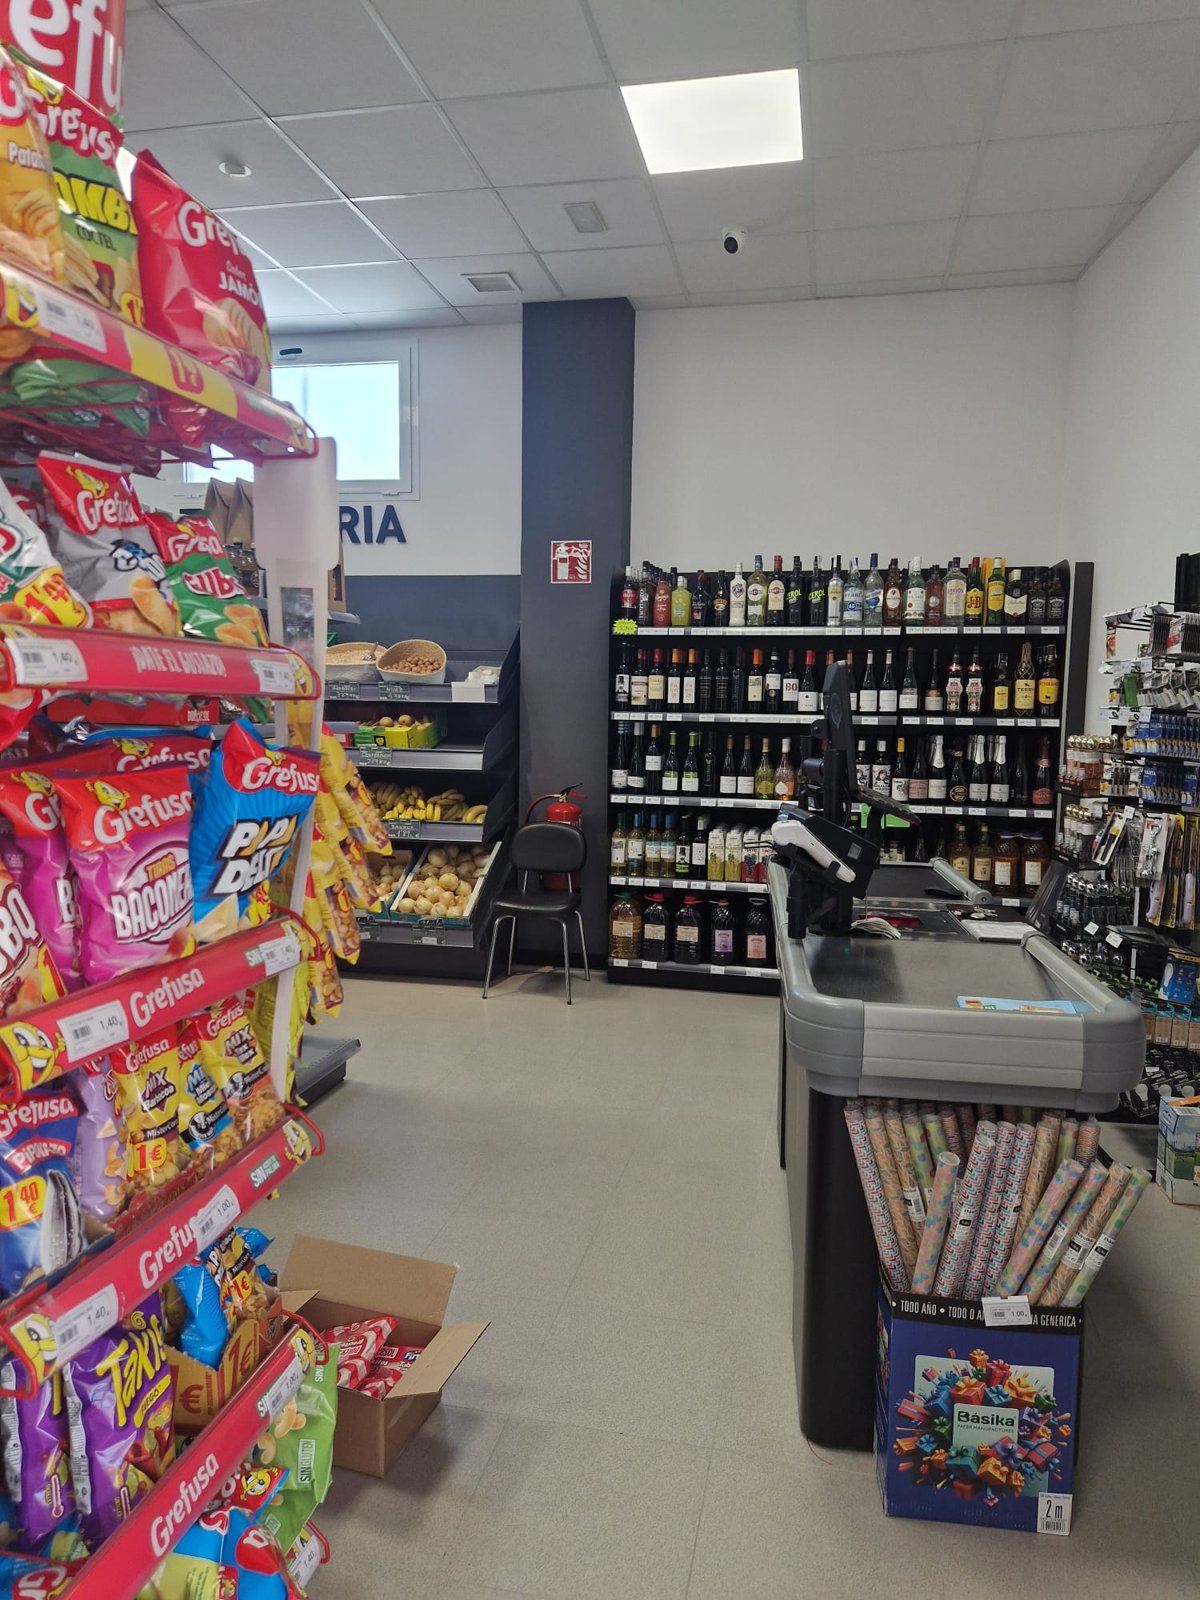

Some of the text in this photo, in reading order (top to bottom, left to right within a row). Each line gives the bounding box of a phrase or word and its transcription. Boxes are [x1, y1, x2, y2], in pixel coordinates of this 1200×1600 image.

[218, 271, 260, 307] JAMÓ
[129, 965, 206, 1029] Grefusa
[125, 1038, 170, 1072] Grefusa
[900, 1300, 938, 1316] TODO AÑO
[948, 1306, 968, 1319] TODO
[1040, 1313, 1077, 1328] GENERICA
[957, 1410, 1015, 1427] Básika
[150, 1453, 220, 1557] Grefusa
[1046, 1499, 1063, 1519] 2 m
